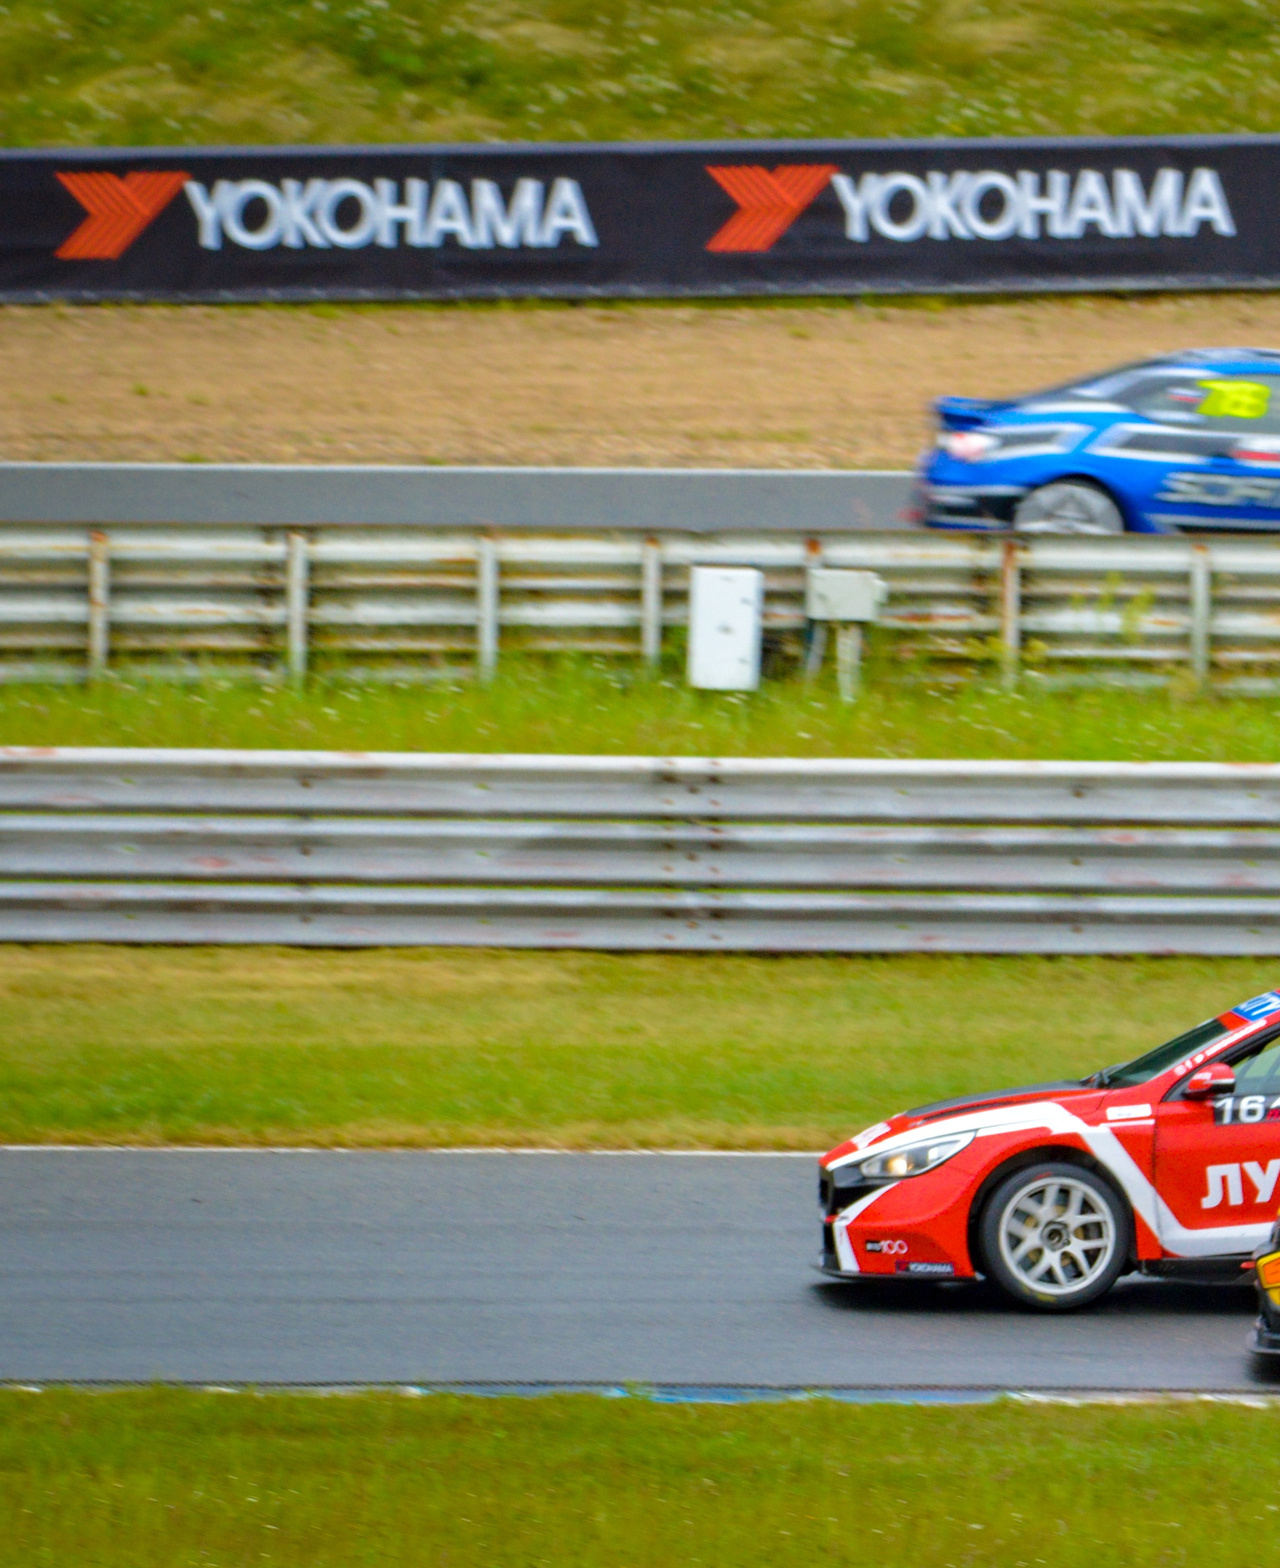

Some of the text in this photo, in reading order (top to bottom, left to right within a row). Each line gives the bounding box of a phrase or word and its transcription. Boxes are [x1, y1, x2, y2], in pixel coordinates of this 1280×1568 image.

[184, 177, 599, 249] YOKOHAMA
[831, 168, 1237, 242] YOKOHAMA
[1215, 1096, 1265, 1124] 16
